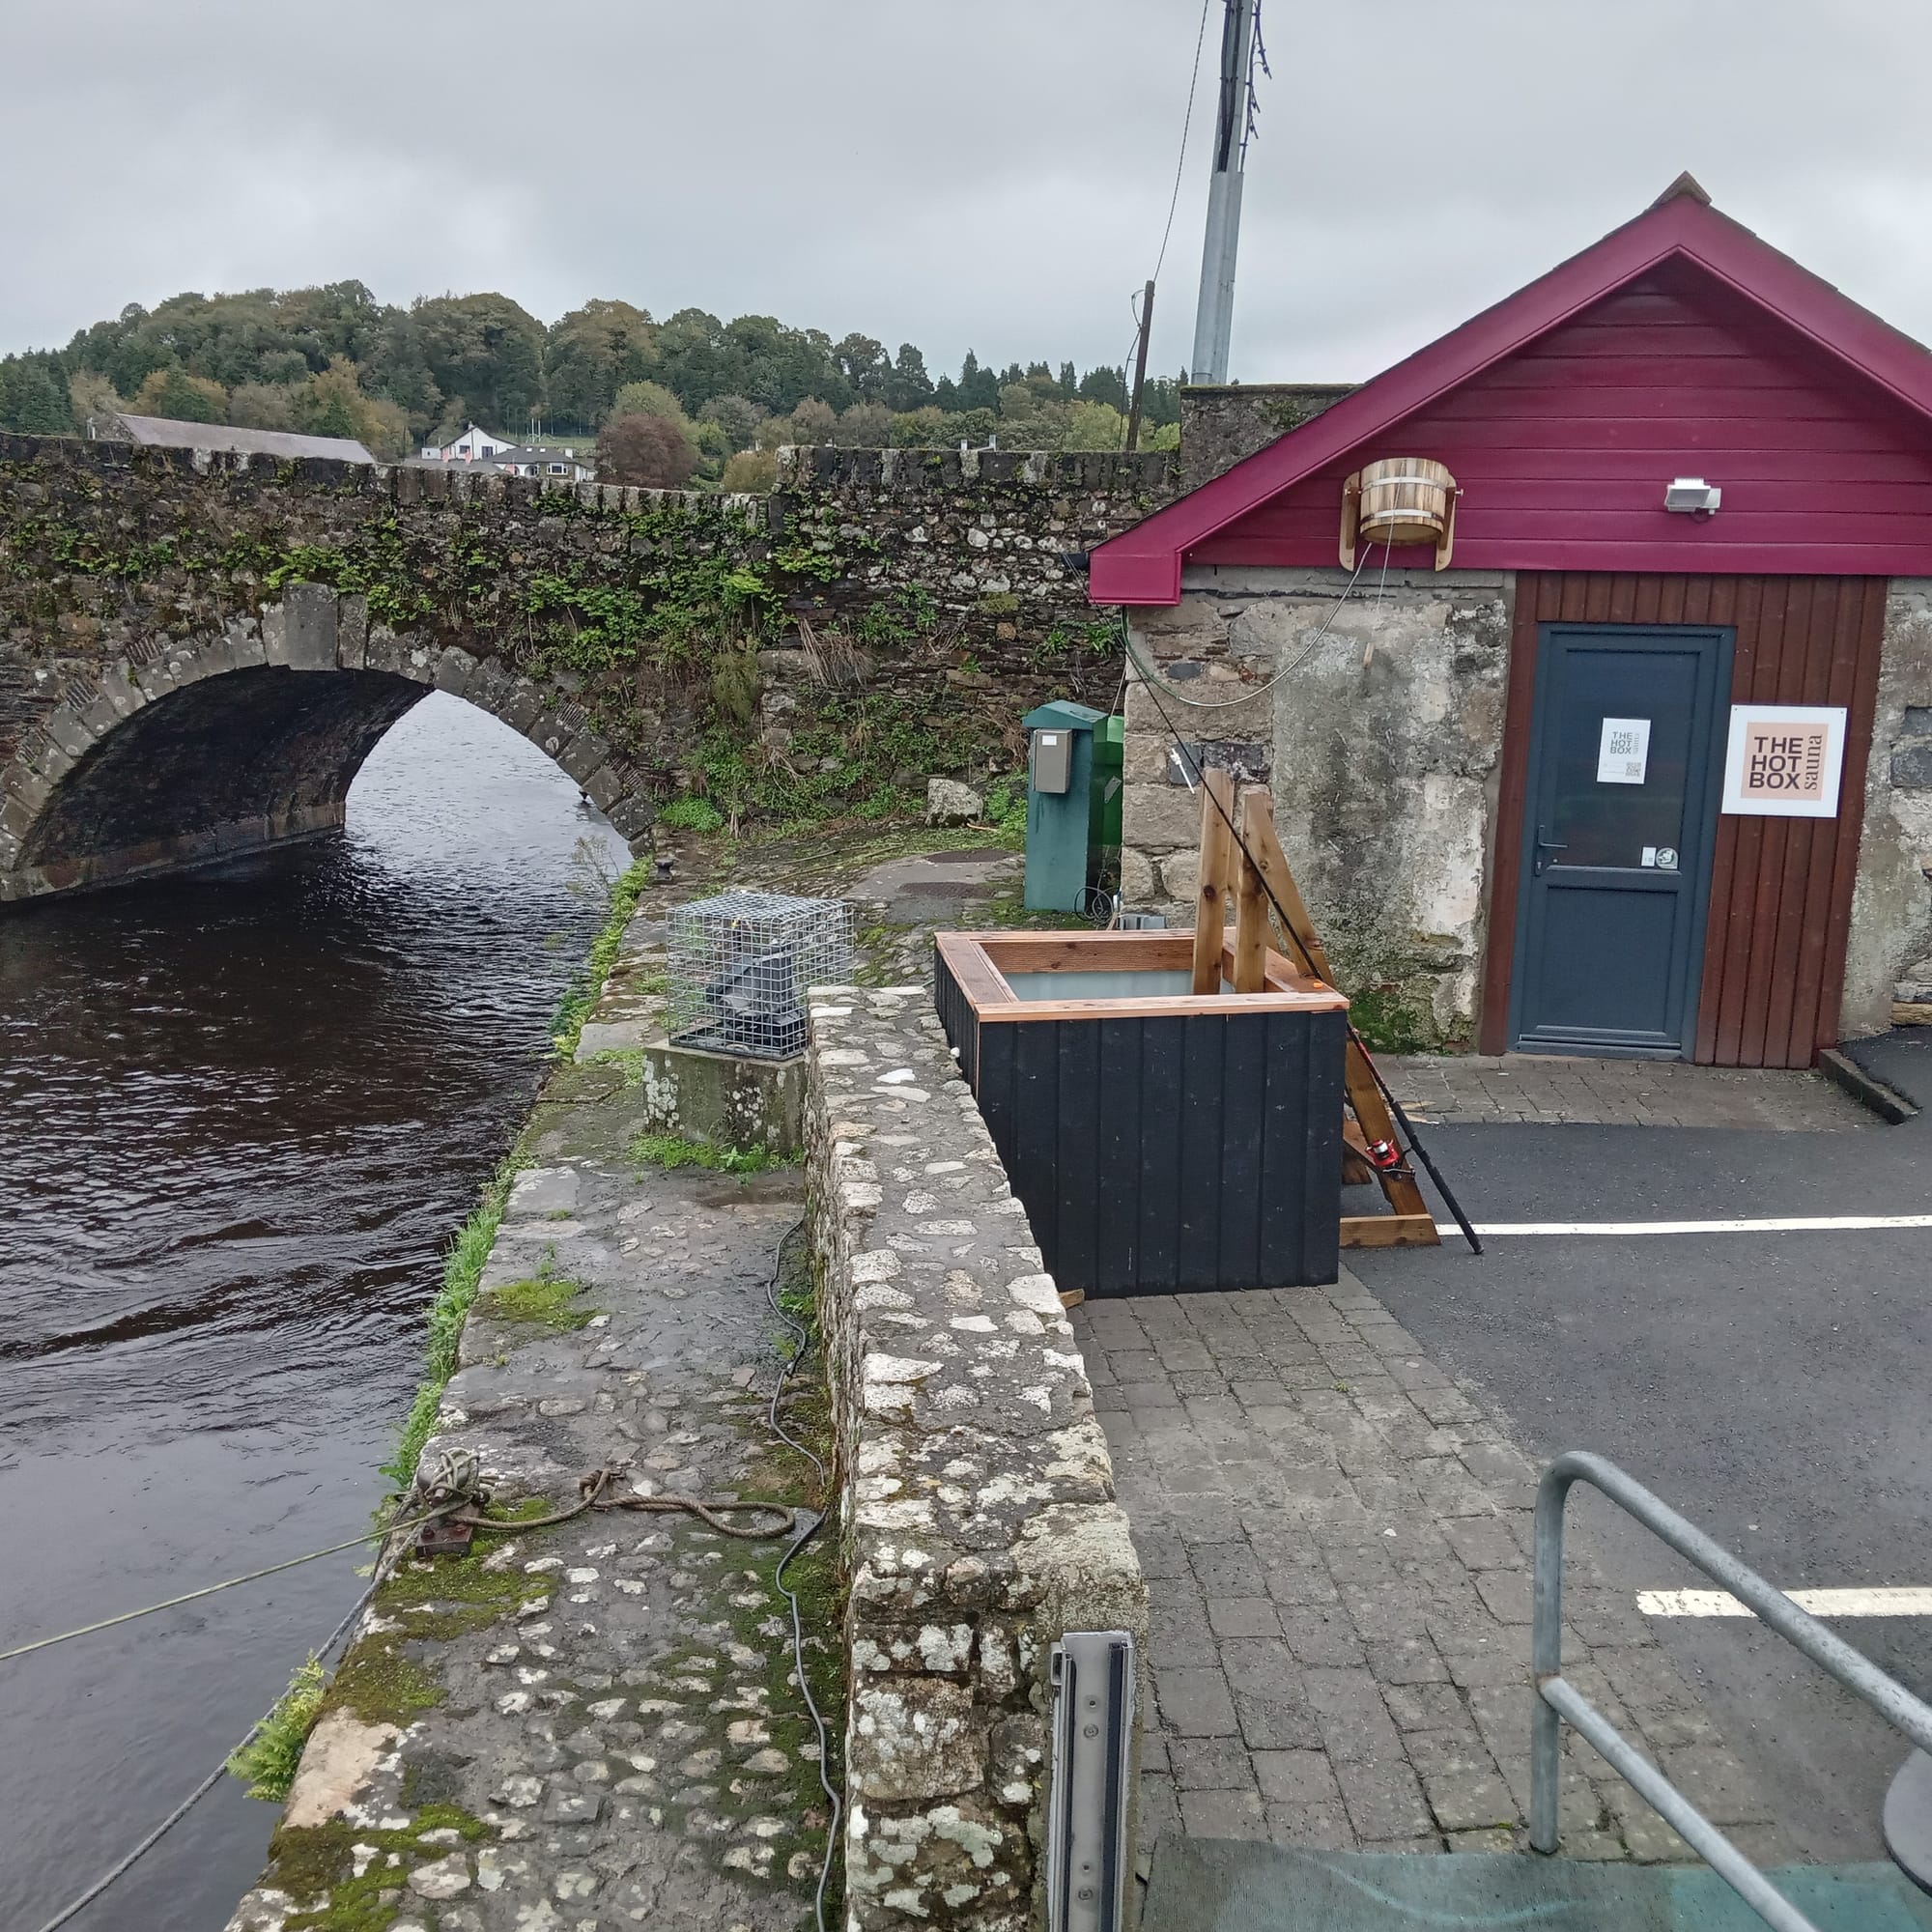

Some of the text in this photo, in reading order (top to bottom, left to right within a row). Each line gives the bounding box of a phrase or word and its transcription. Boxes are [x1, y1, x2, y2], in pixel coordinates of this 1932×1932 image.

[1609, 746, 1632, 754] BOX
[1753, 736, 1804, 754] THE
[1750, 754, 1803, 773] HOT
[1804, 734, 1823, 790] sauna
[1748, 772, 1802, 789] BOX
